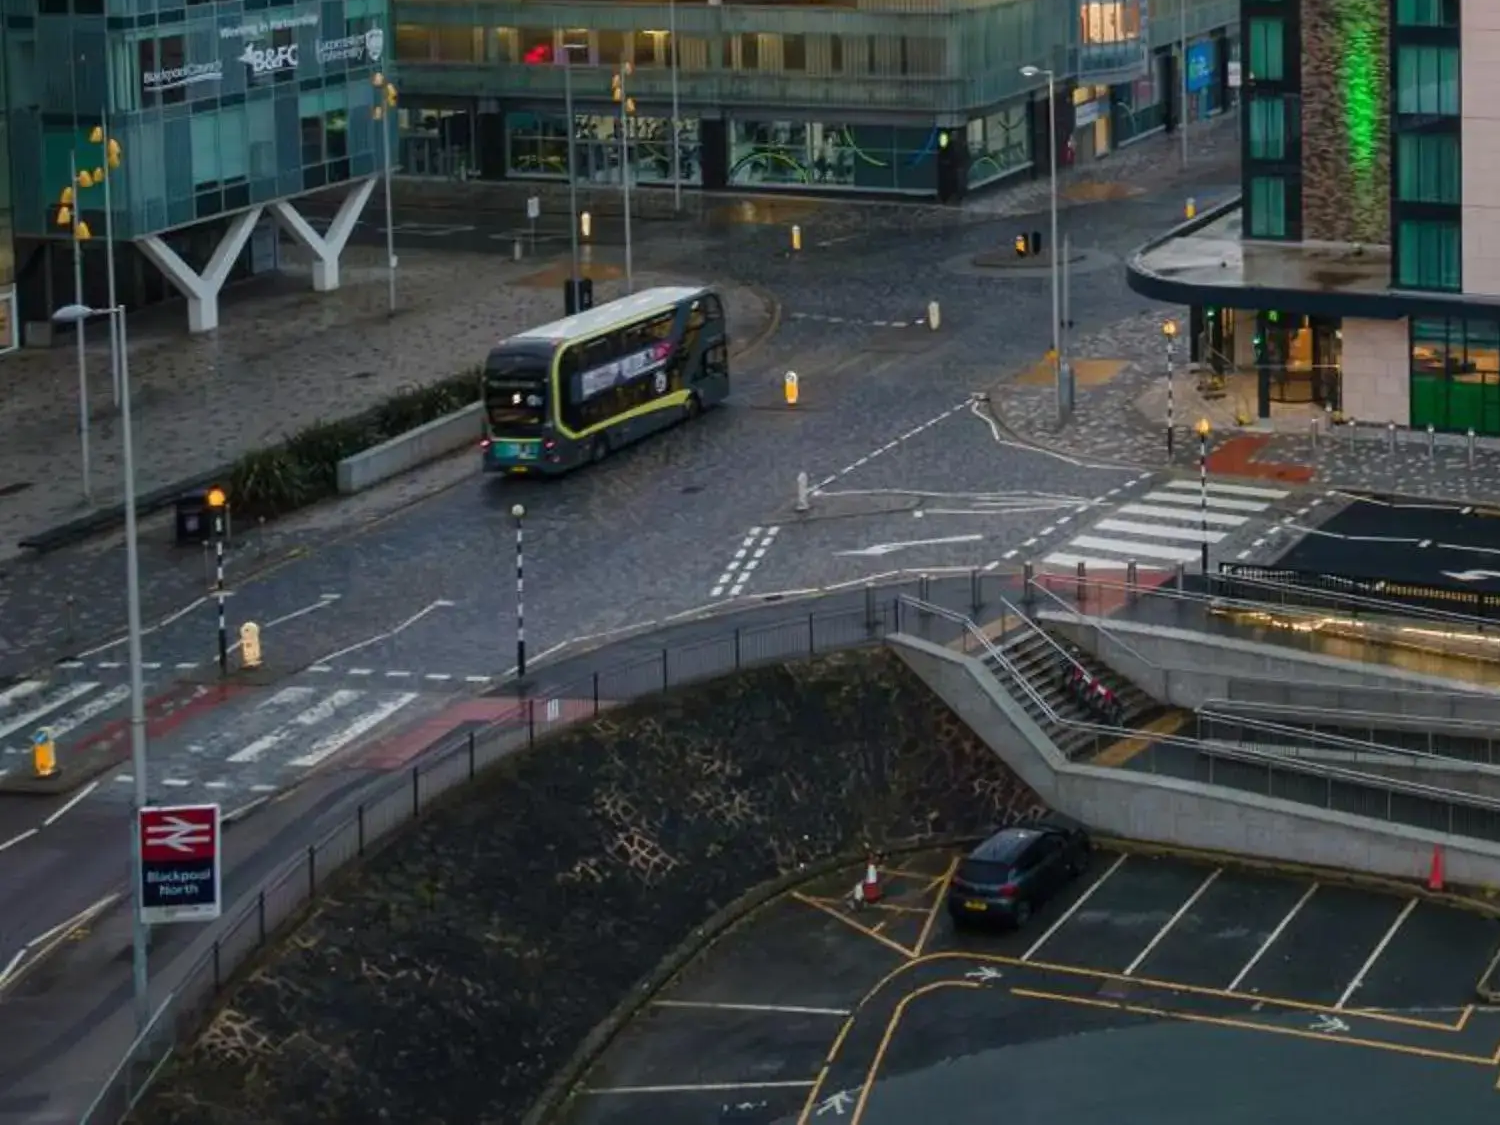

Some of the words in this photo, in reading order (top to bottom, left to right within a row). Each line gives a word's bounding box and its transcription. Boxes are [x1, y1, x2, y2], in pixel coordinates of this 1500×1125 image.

[252, 44, 298, 72] B&FC
[147, 868, 211, 884] Blackpool
[159, 884, 200, 897] North
